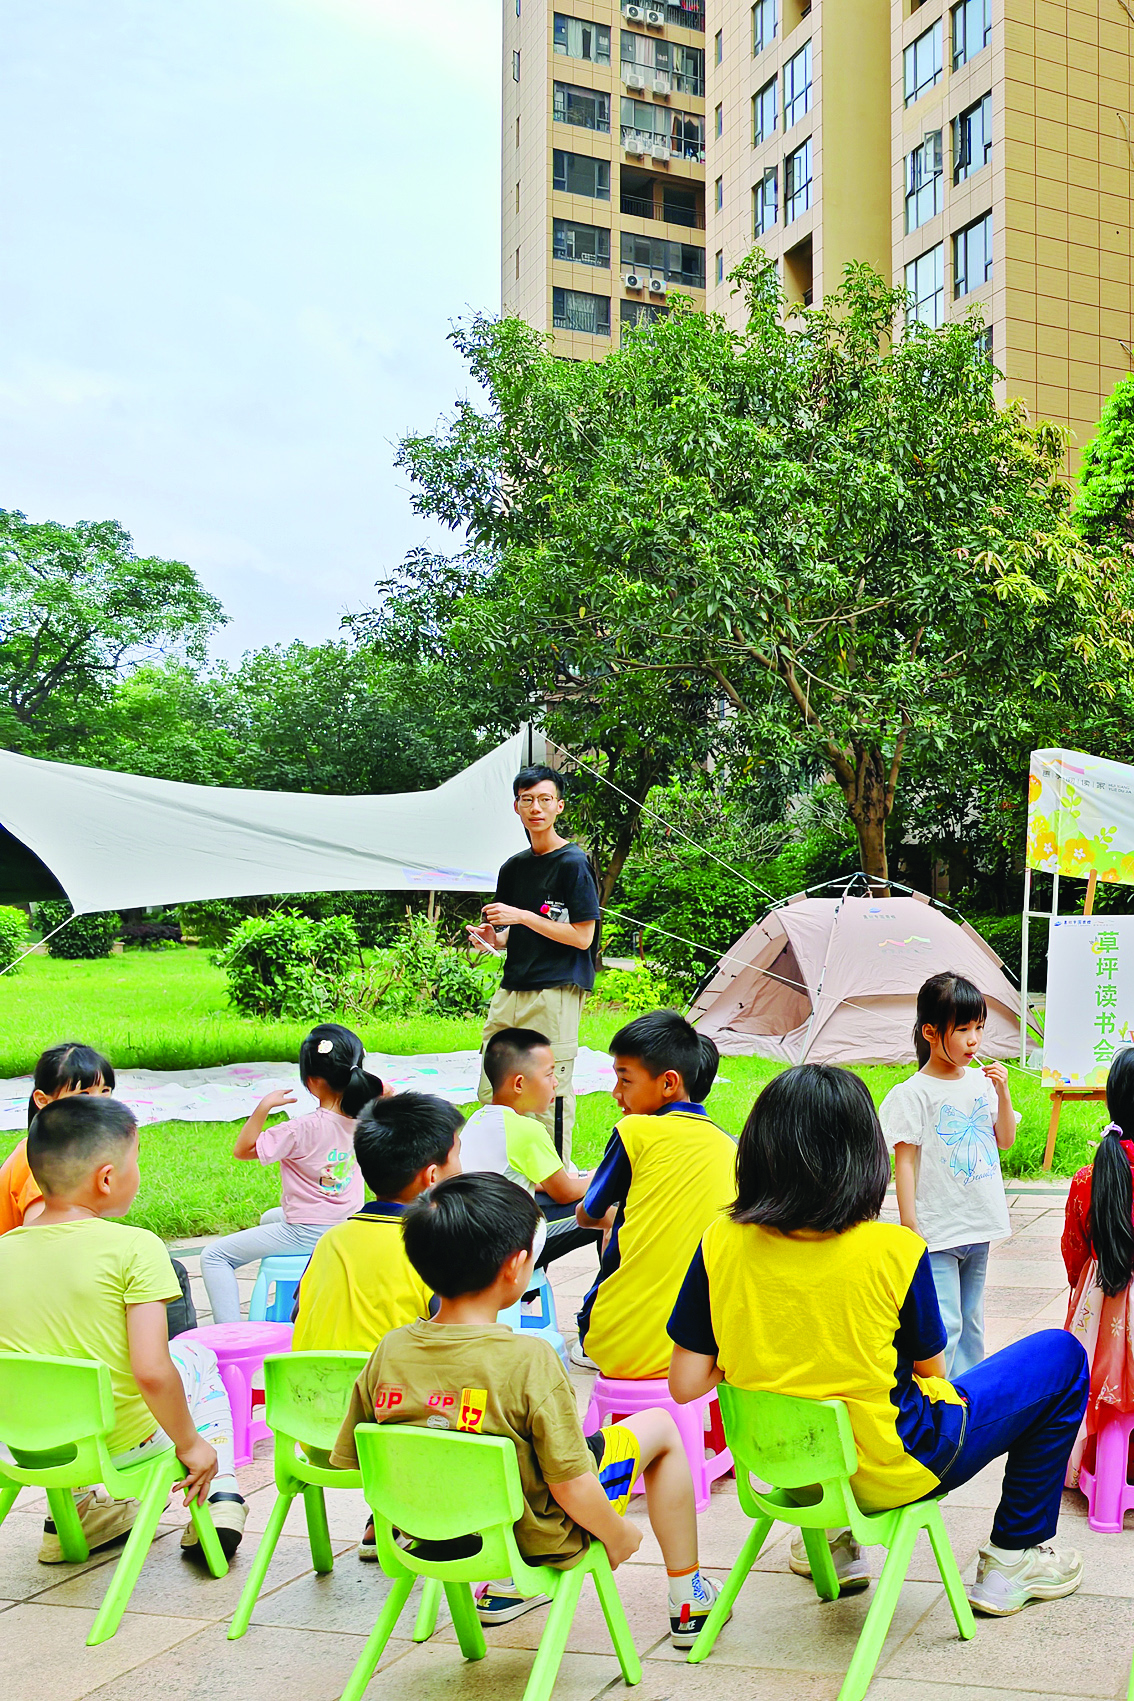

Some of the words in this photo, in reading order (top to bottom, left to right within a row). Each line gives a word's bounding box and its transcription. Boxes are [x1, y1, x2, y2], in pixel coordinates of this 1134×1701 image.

[1093, 931, 1120, 1063] 草坪读书会
[428, 1395, 454, 1408] UP
